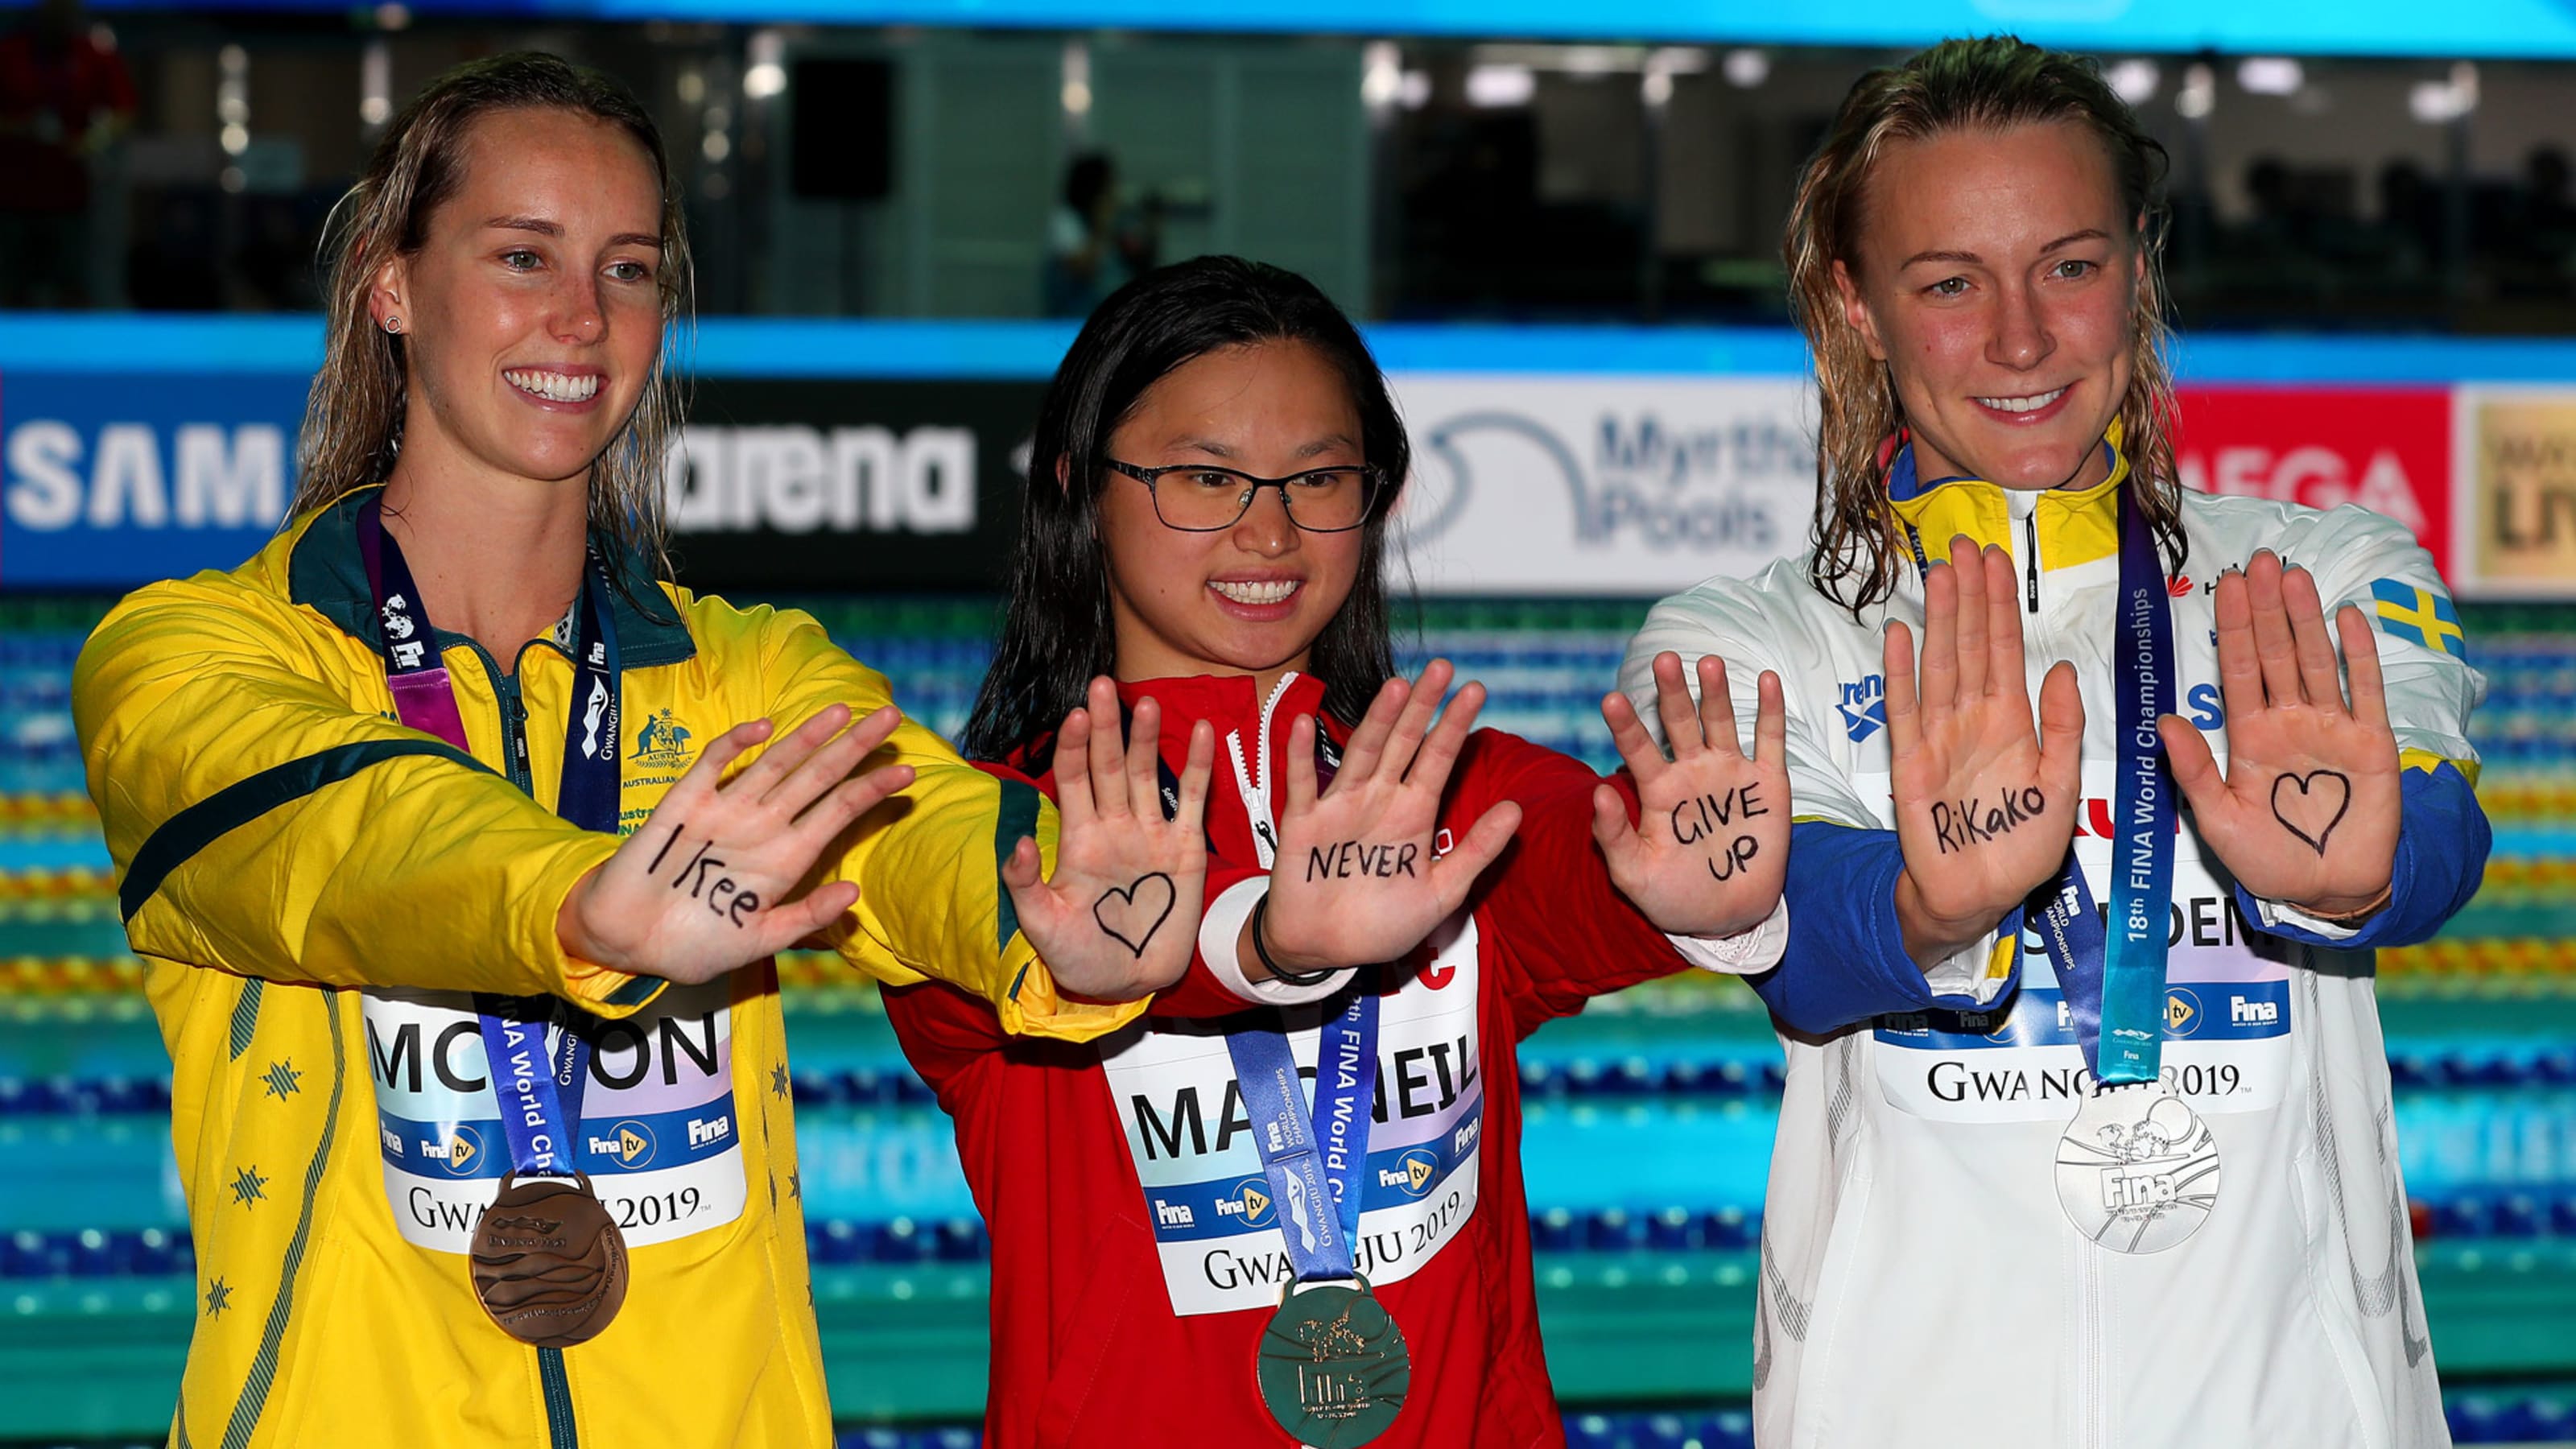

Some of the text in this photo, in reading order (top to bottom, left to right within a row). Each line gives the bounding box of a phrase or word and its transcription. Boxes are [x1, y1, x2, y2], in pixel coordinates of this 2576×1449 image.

[662, 424, 974, 532] arena
[1599, 487, 1777, 547] Pools
[2128, 587, 2159, 943] 18th FINA World Championships
[1671, 782, 1769, 845] GIVE
[1307, 840, 1417, 882] NEVER
[1708, 834, 1759, 881] UP
[2231, 995, 2277, 1022] Fina
[366, 1009, 718, 1092] MCON
[1336, 1029, 1361, 1089] FINA
[510, 1050, 547, 1128] World
[1131, 1035, 1477, 1161] MAEIL
[421, 1139, 451, 1158] Fina
[455, 1142, 469, 1158] tv
[588, 1135, 641, 1154] Fina tv
[687, 1116, 729, 1145] Fina
[1267, 1121, 1285, 1154] Fina
[1327, 1096, 1355, 1171] World
[1455, 1117, 1479, 1154] Fina
[1378, 1166, 1427, 1187] Fina tv
[2100, 1166, 2178, 1209] Fina
[618, 1187, 700, 1228] 2019
[1154, 1199, 1194, 1225] Fina
[1214, 1196, 1263, 1216] Fina tv
[1308, 1186, 1333, 1248] GWANGJU
[1410, 1191, 1460, 1254] 2019
